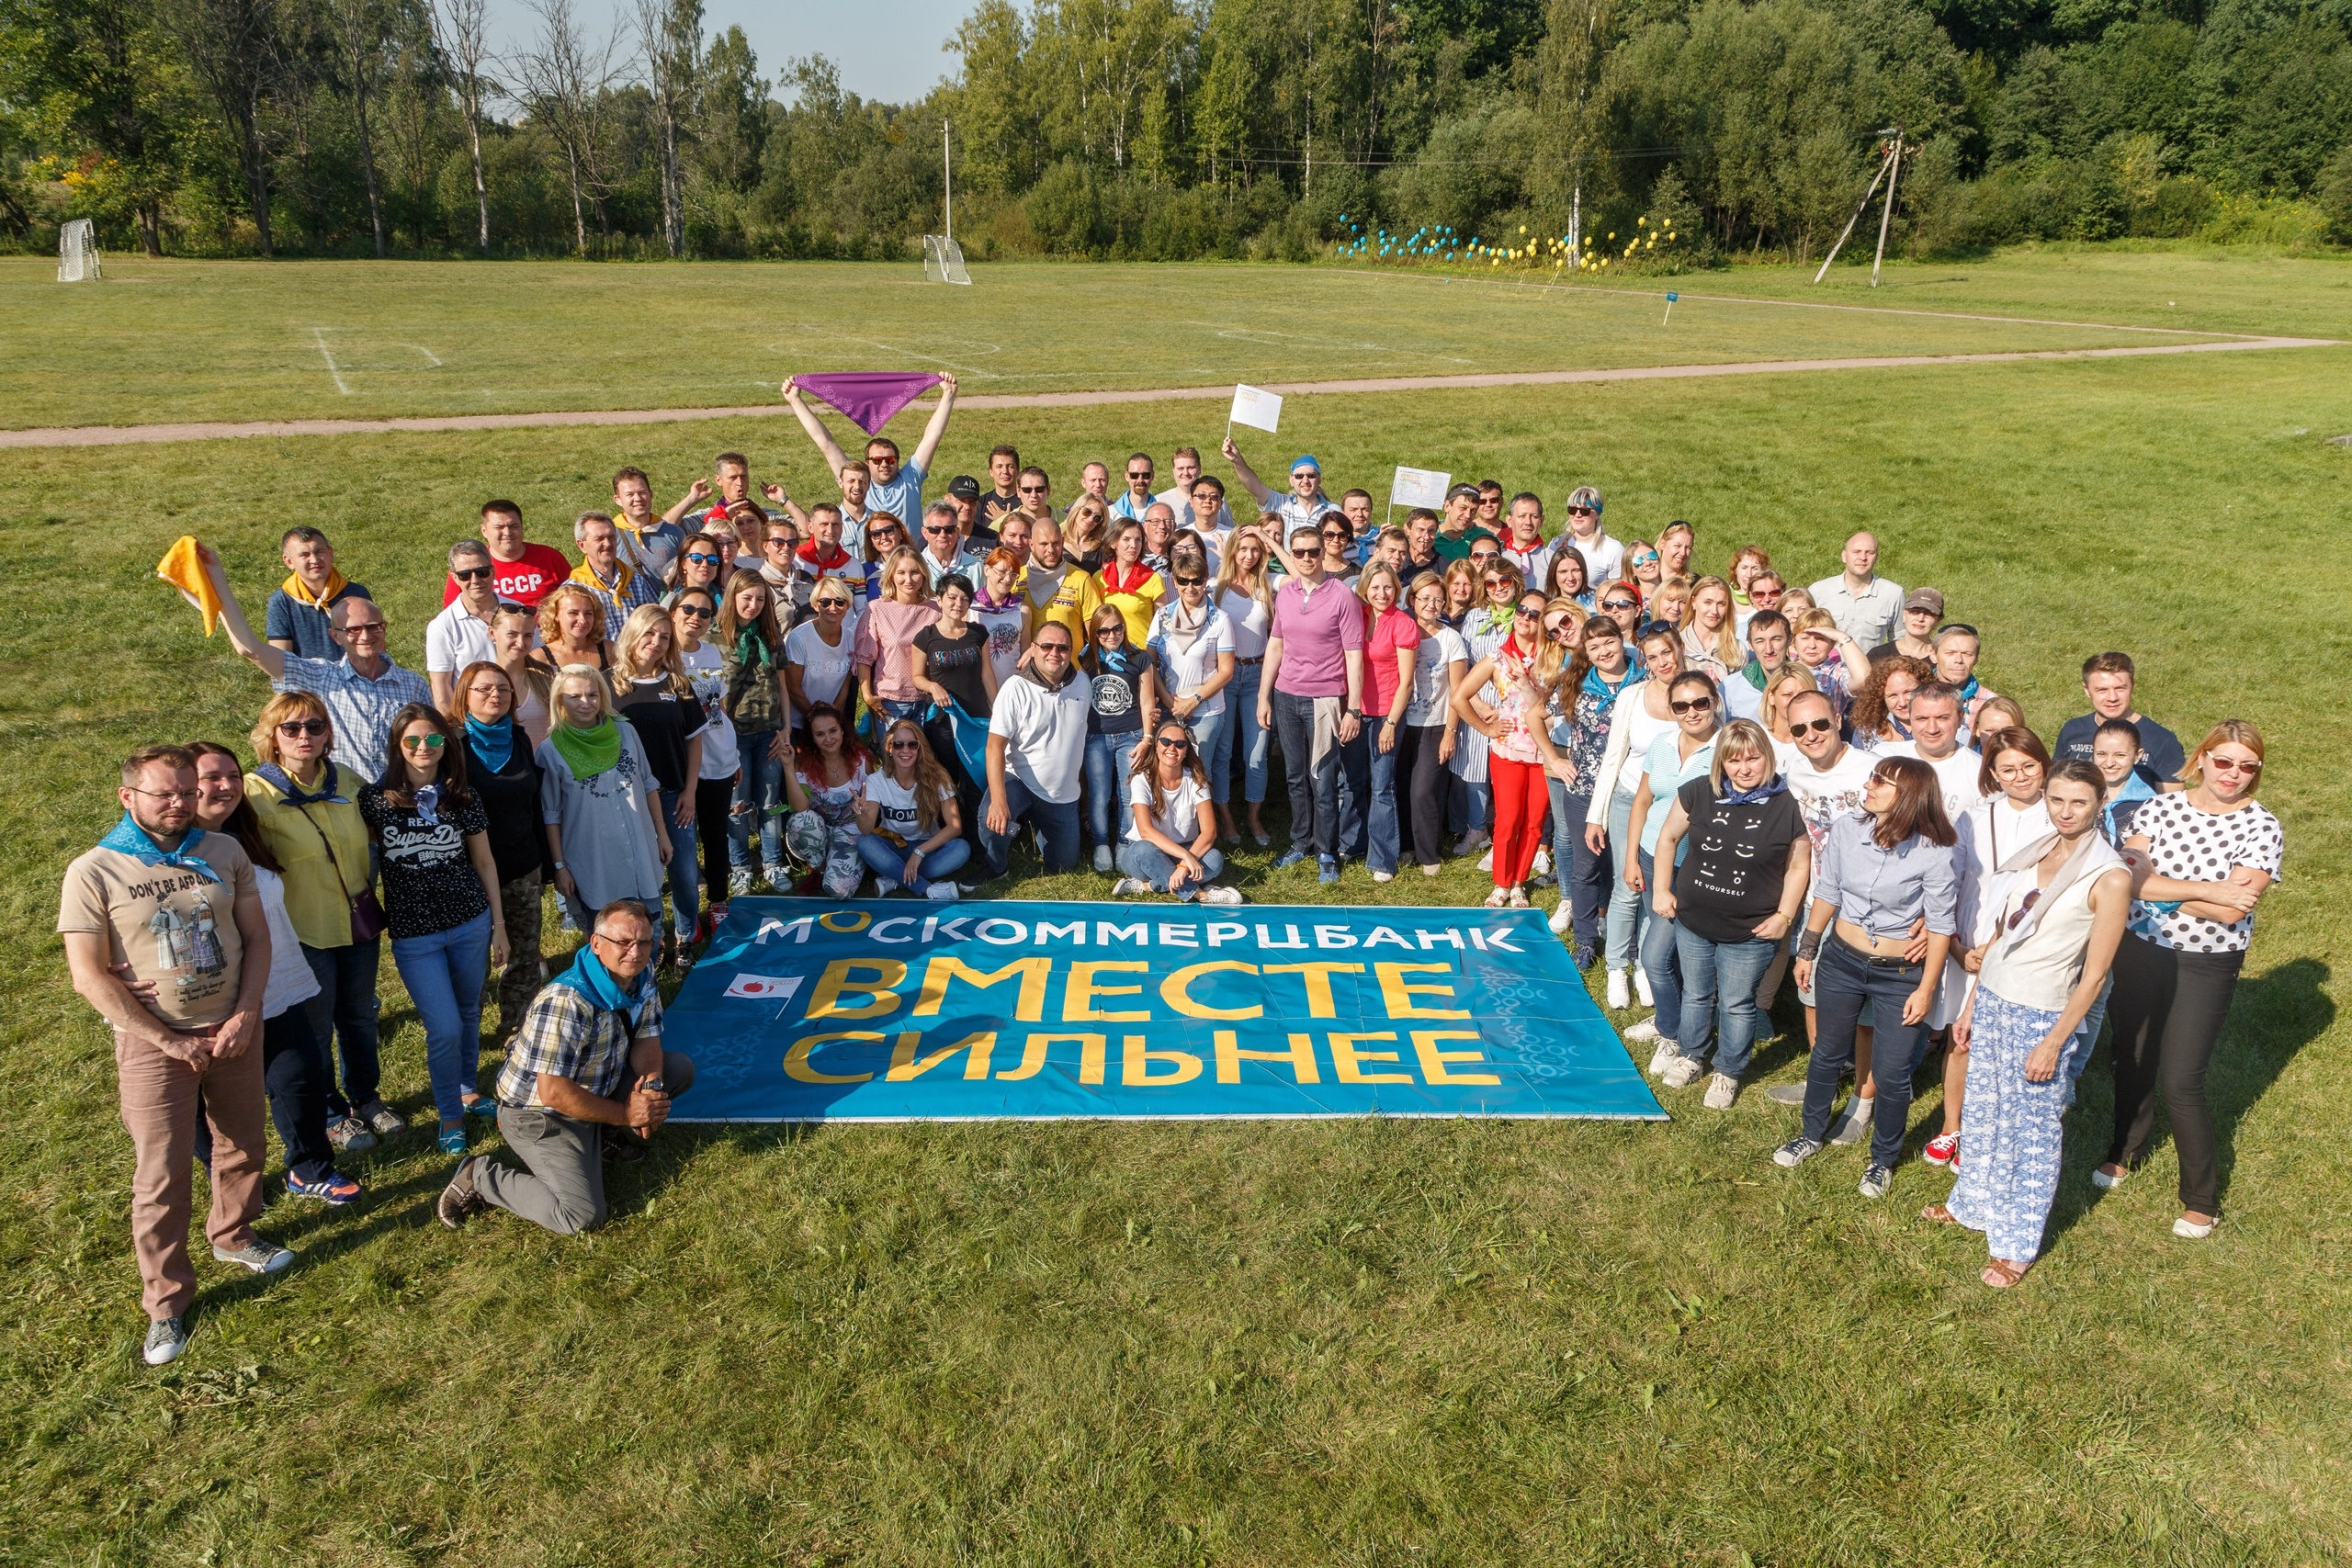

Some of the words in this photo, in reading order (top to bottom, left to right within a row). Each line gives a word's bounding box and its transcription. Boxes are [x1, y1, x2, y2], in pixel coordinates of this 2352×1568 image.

[408, 818, 438, 827] REA
[129, 878, 161, 899] DON'T
[164, 878, 178, 894] BE
[1704, 884, 1746, 897] YOURSELF
[754, 910, 1525, 953] МОСКОММЕРЦБАНК
[803, 957, 1472, 1022] ВМЕСТЕ
[783, 1030, 1502, 1086] СИЛЬНЕЕ
